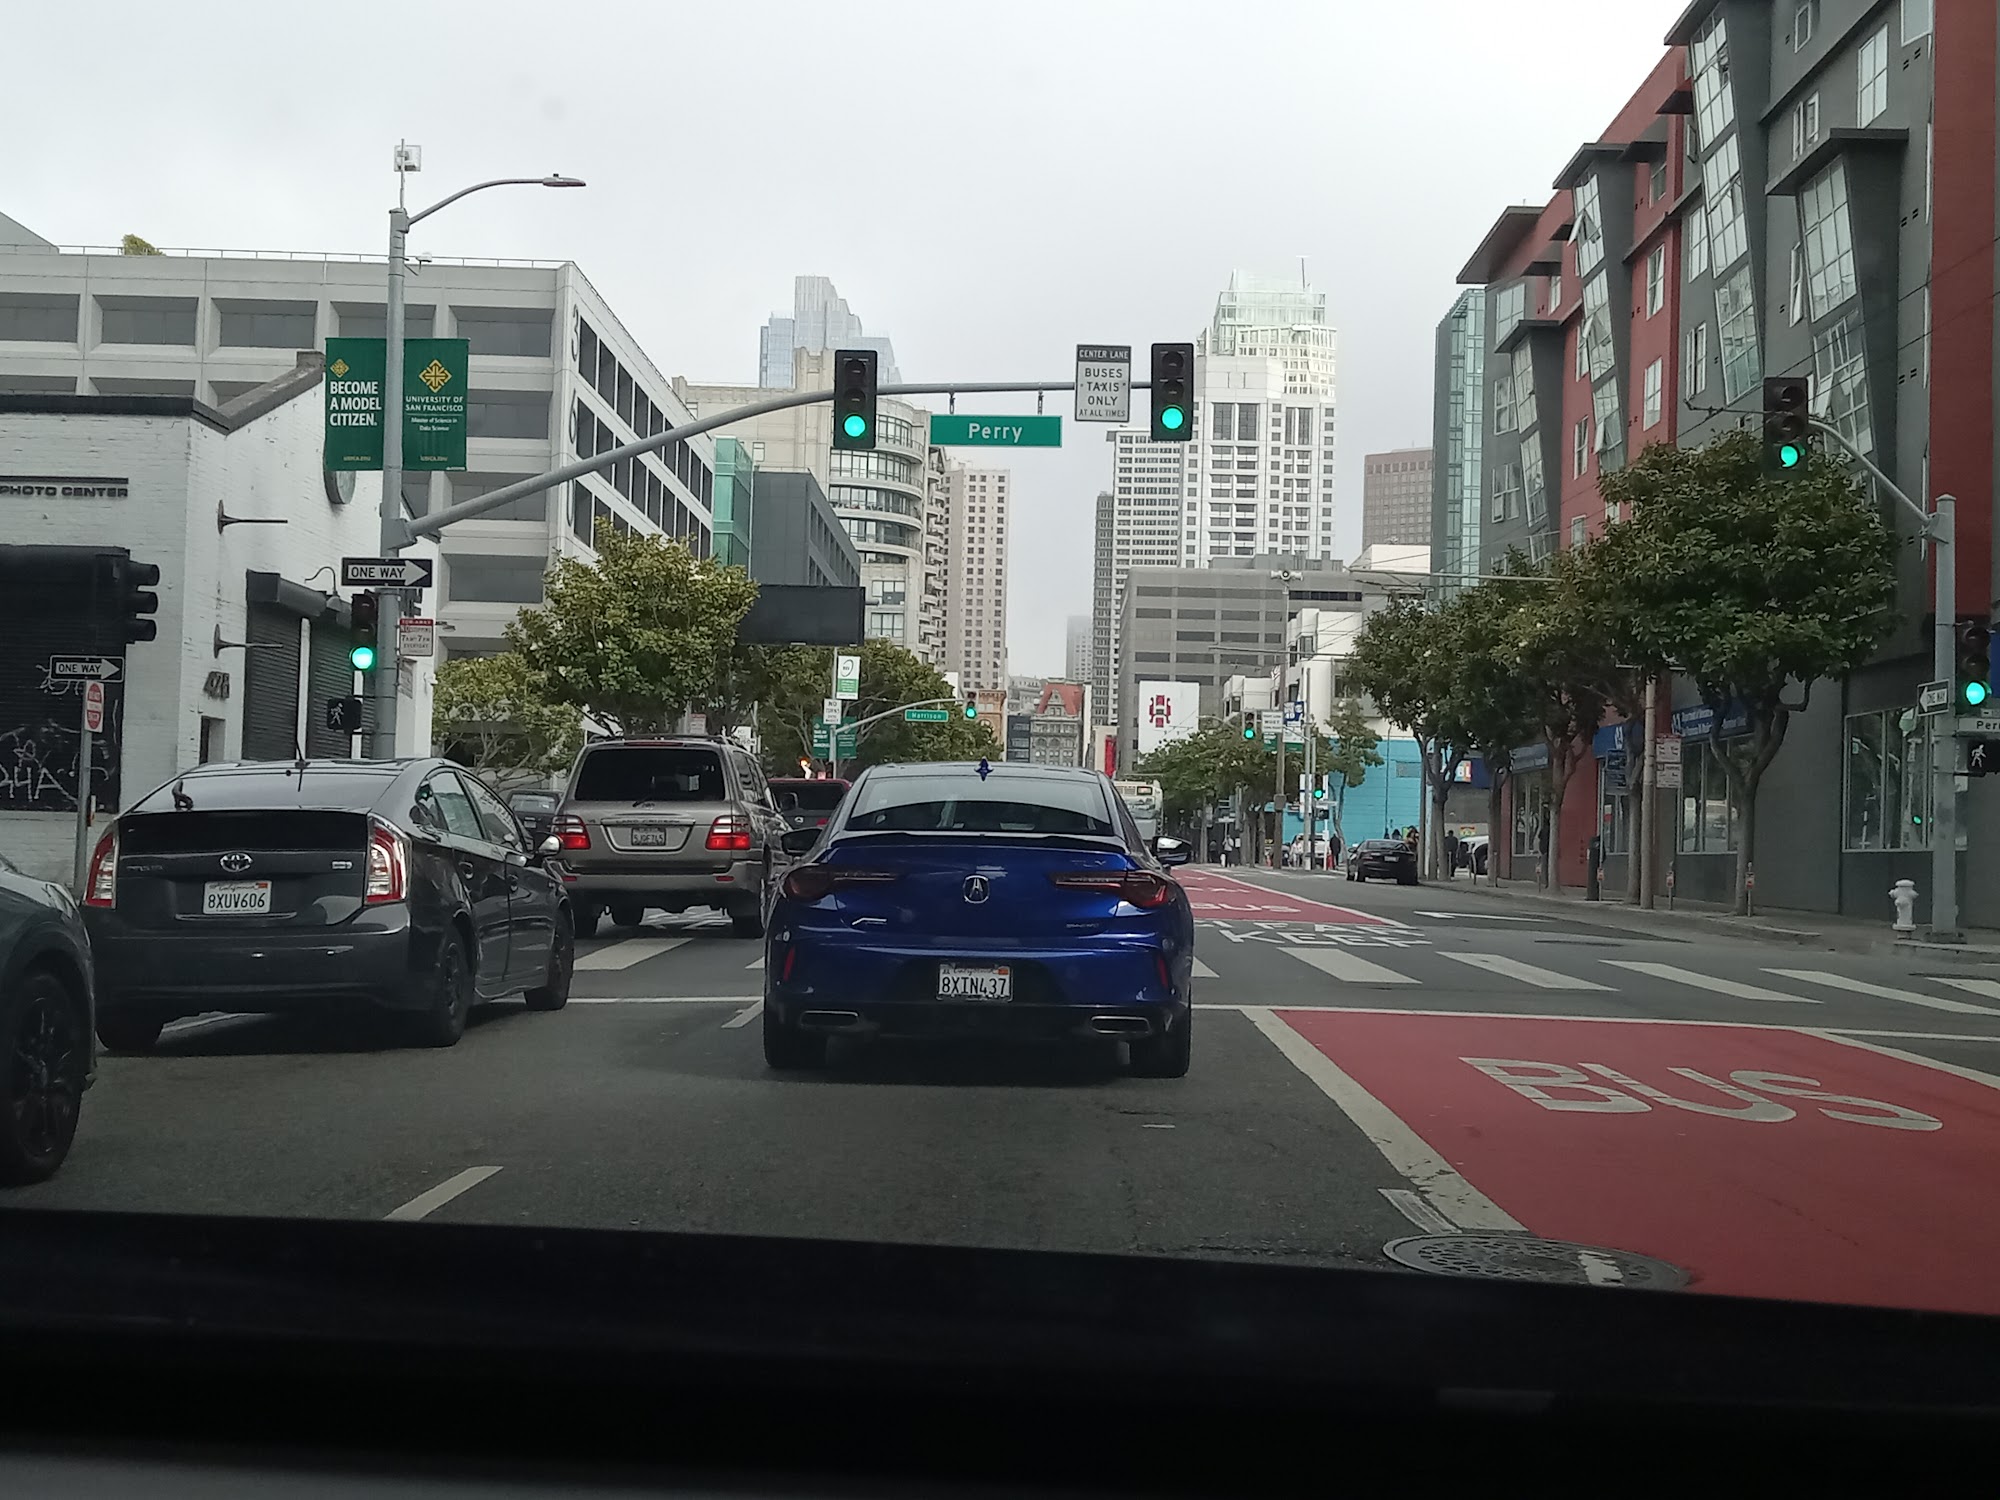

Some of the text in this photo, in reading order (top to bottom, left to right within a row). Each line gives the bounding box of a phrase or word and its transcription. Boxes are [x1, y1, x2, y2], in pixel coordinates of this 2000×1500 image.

[1079, 349, 1129, 359] CENTER LANE
[1085, 368, 1123, 378] BUSES
[330, 381, 378, 395] BECOME
[1087, 382, 1119, 392] TAXIS
[330, 397, 382, 411] A MODEL
[406, 395, 463, 404] UNIVERSITY OF
[1088, 395, 1118, 406] ONLY
[405, 404, 464, 412] SAN FRANCISCO
[1089, 409, 1102, 417] ALL
[1105, 409, 1126, 418] TIMES
[330, 413, 378, 427] CITIZEN.
[968, 423, 1023, 442] Perry
[61, 486, 128, 497] CENTER
[351, 567, 405, 578] ONE WAY
[58, 663, 102, 673] ONE WAY
[1927, 691, 1946, 704] ONE WAY
[208, 892, 266, 909] 8XUV606
[942, 976, 1007, 995] 8XIN437
[1459, 1055, 1944, 1132] BUS
